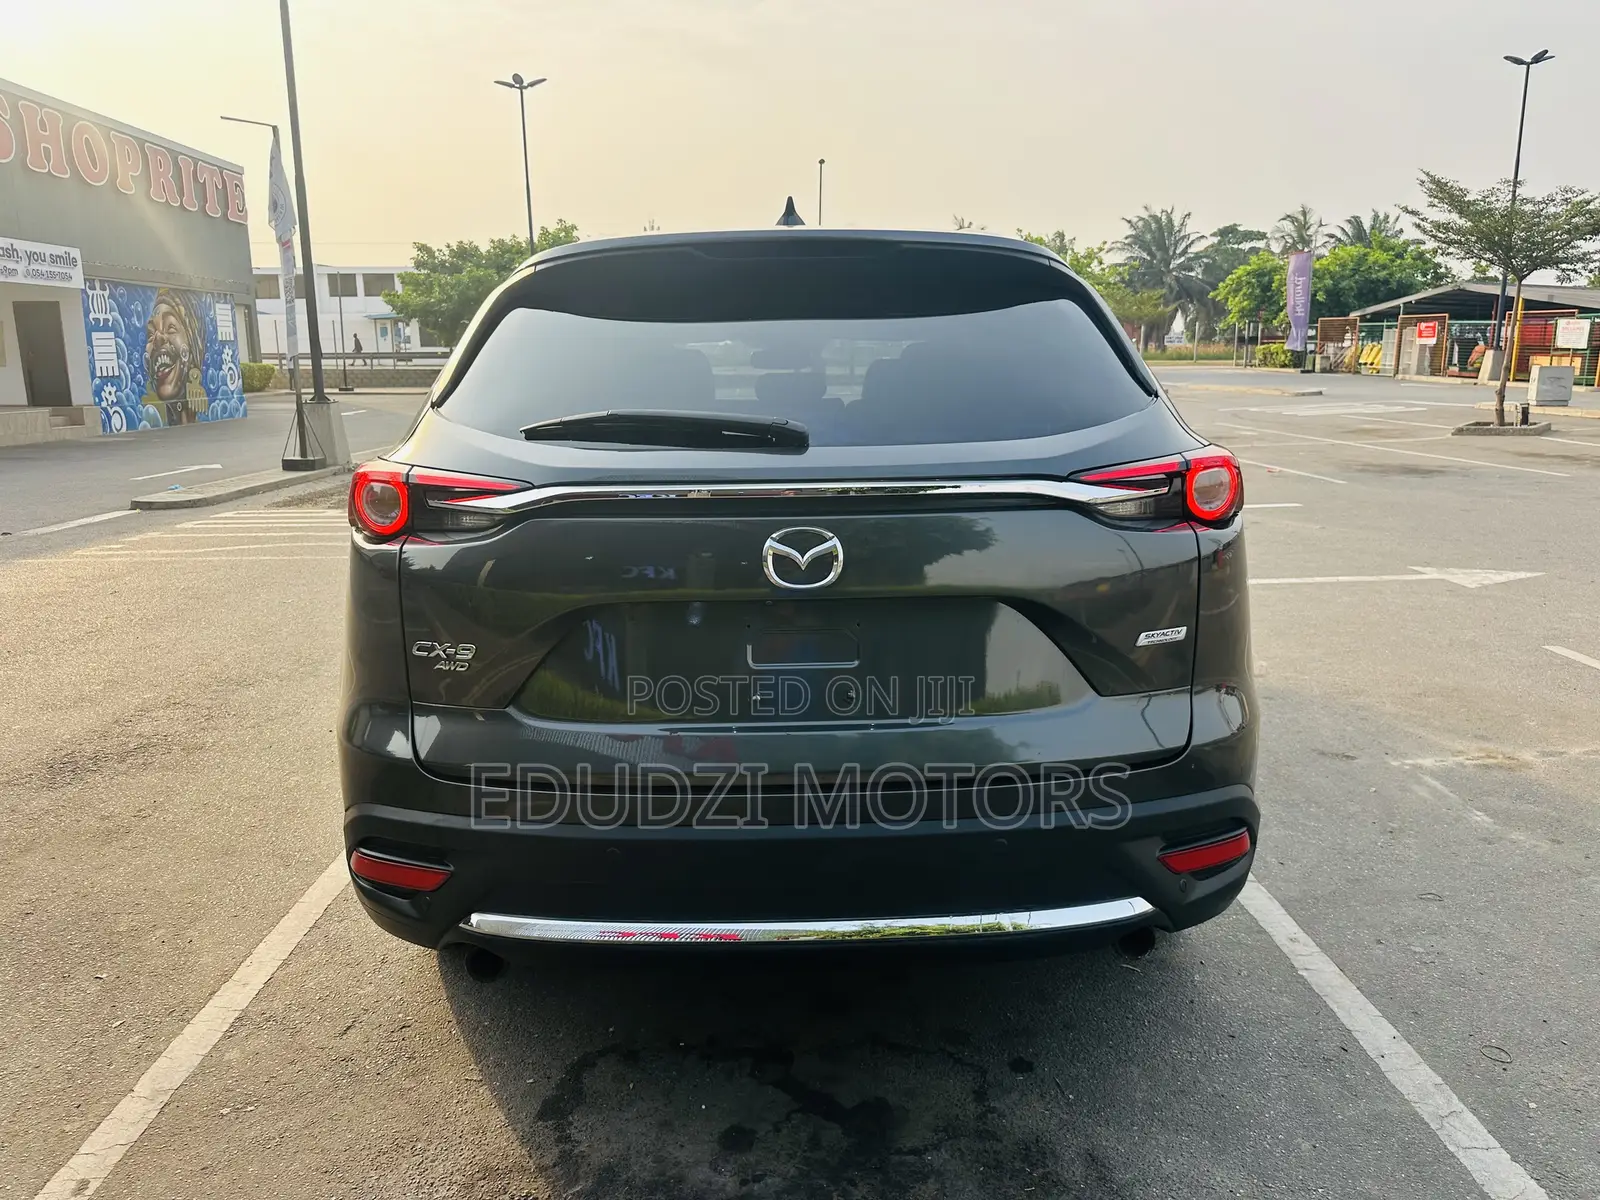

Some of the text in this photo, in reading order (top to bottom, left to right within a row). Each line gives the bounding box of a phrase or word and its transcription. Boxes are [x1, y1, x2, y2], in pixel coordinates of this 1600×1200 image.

[24, 250, 47, 266] you
[49, 250, 78, 267] smile
[1144, 628, 1183, 639] SKYACTIV
[412, 640, 476, 660] CX-9
[433, 660, 469, 672] AWD
